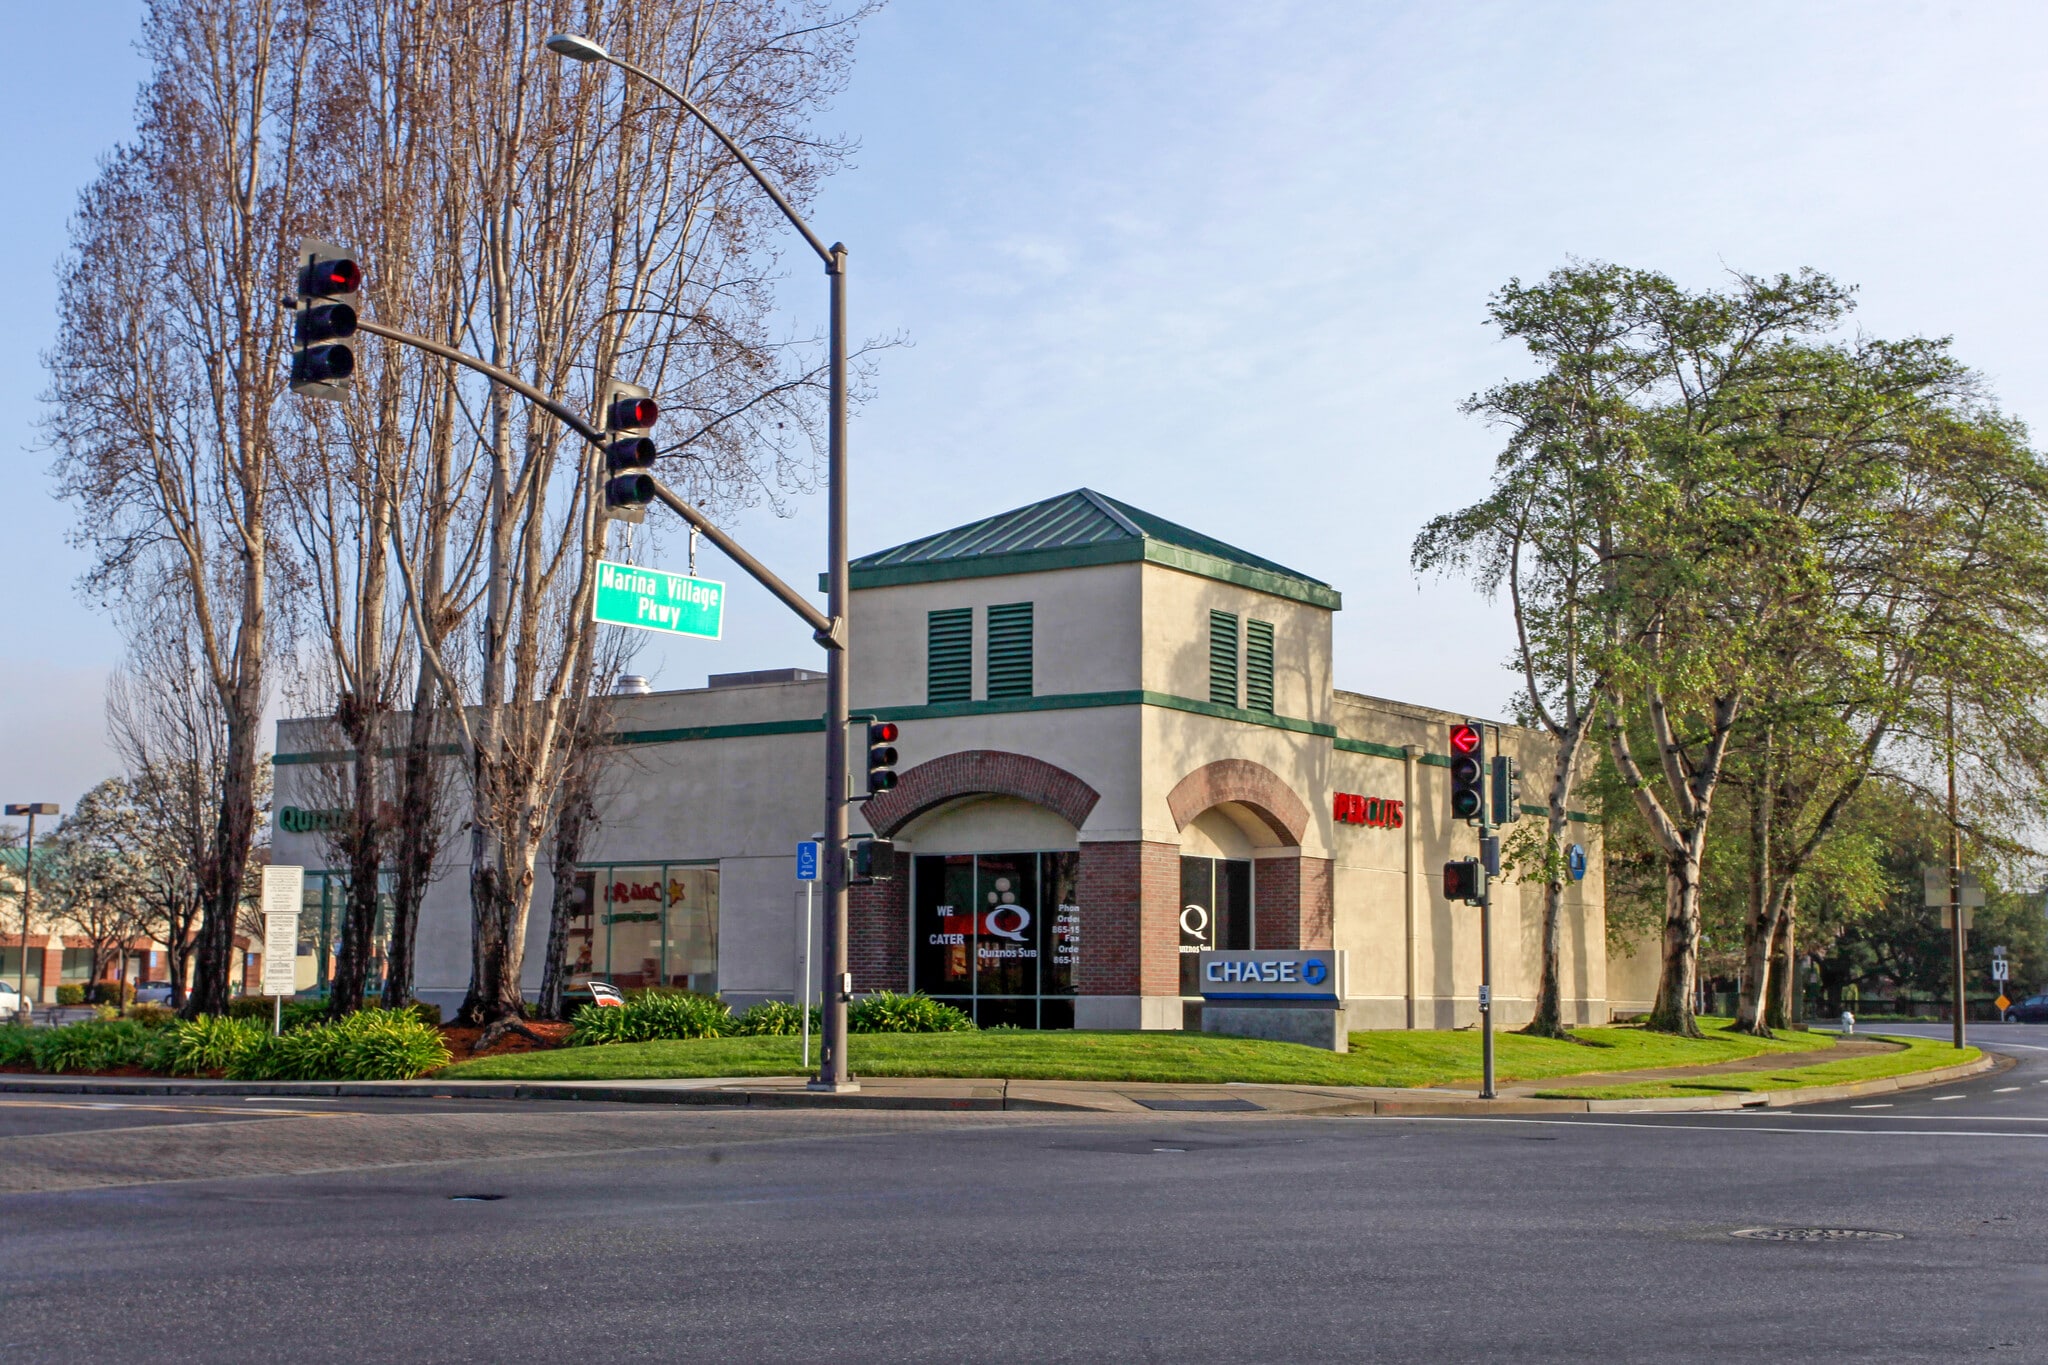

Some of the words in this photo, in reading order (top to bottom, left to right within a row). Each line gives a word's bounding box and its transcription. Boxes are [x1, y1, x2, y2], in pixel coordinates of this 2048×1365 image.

[602, 565, 656, 595] Marina
[667, 577, 719, 612] Village
[638, 597, 681, 630] Pkwy
[936, 905, 954, 917] WE
[1058, 904, 1080, 912] Phon
[929, 933, 965, 945] CATER
[1206, 961, 1298, 982] CHASE
